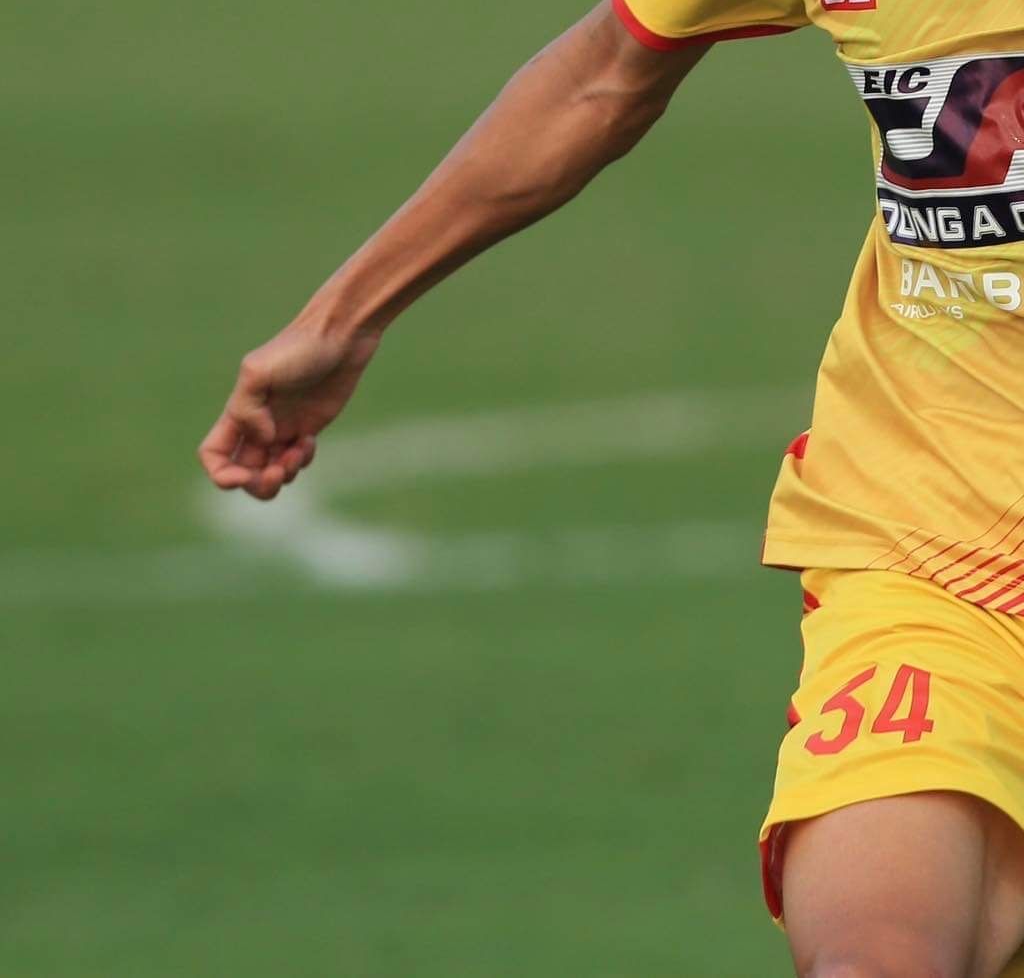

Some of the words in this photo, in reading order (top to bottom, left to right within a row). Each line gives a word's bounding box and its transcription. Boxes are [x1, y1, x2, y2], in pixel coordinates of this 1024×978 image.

[864, 66, 931, 94] EIC
[973, 204, 1006, 240] A
[804, 663, 934, 755] 54
